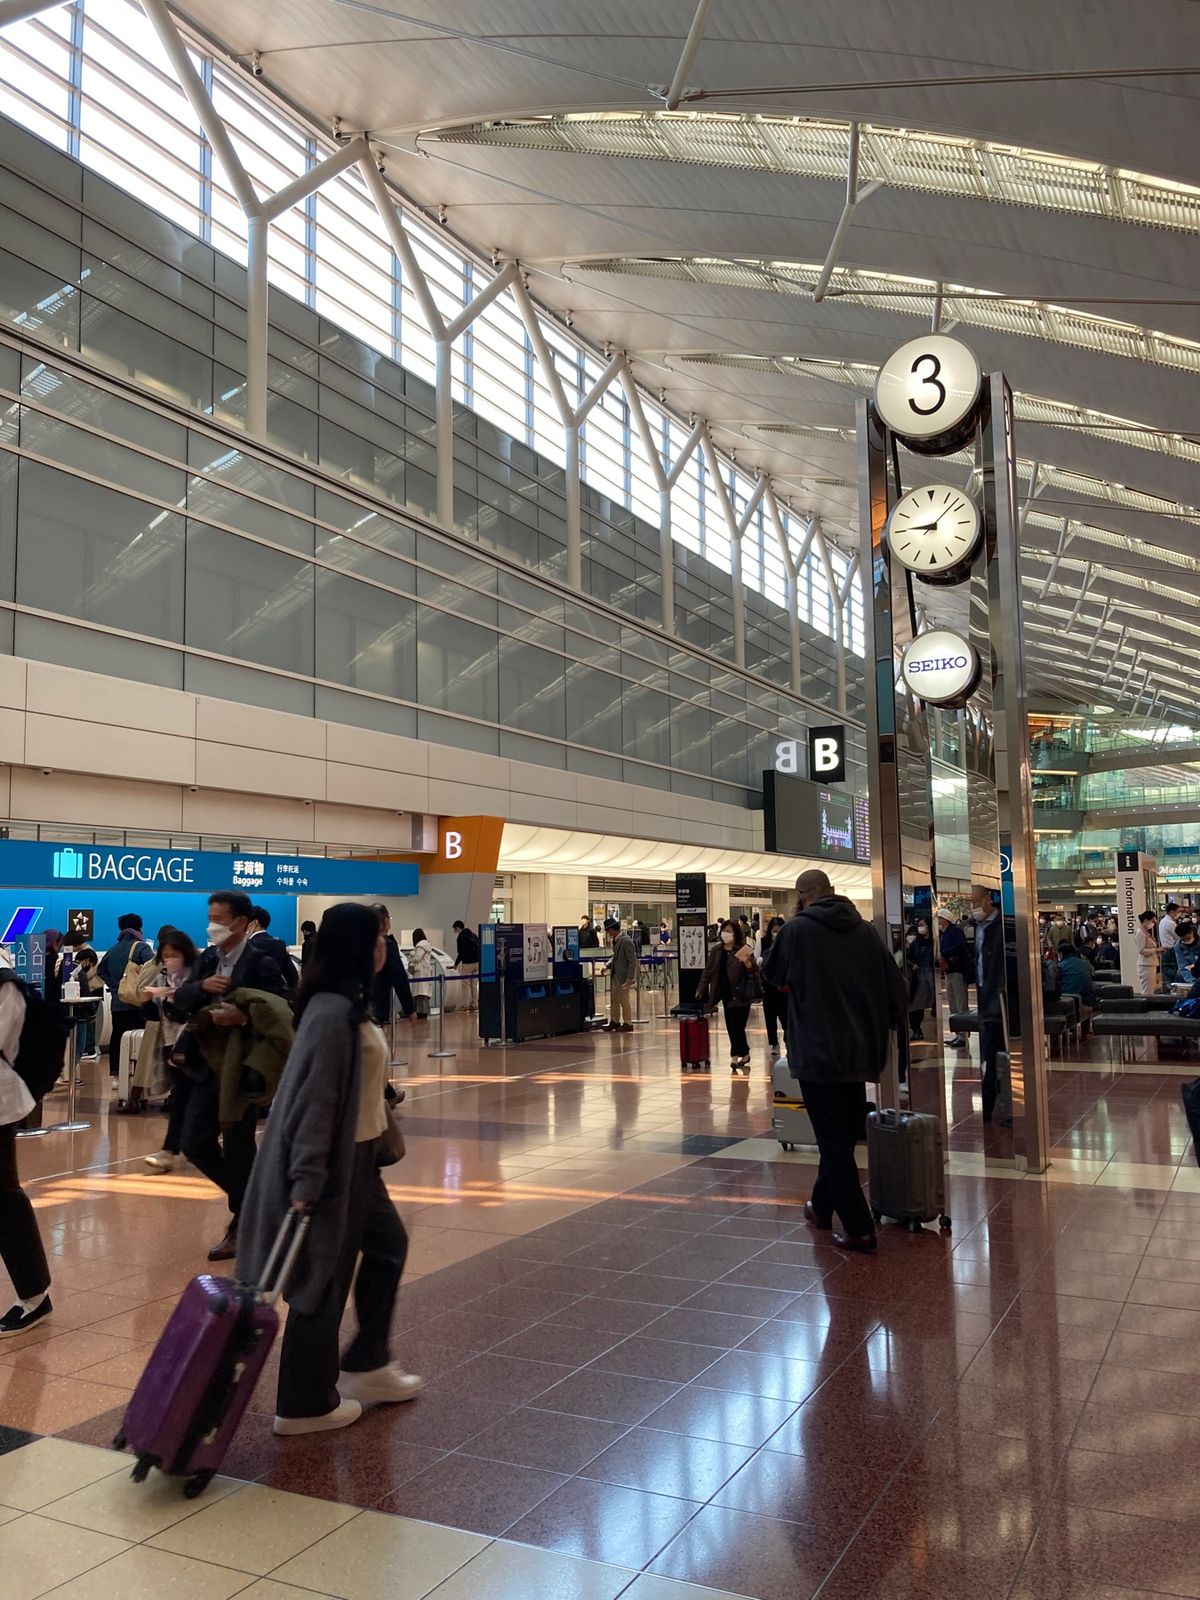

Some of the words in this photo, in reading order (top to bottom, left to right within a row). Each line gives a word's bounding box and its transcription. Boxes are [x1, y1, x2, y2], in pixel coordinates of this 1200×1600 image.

[908, 353, 946, 416] 3
[908, 656, 967, 673] SEIKO
[814, 737, 839, 772] B
[445, 831, 463, 859] B
[88, 853, 194, 883] BAGGAGE
[232, 876, 263, 887] Baggage
[233, 861, 264, 876] 手荷物
[1158, 864, 1190, 875] Market
[1125, 877, 1135, 935] Information
